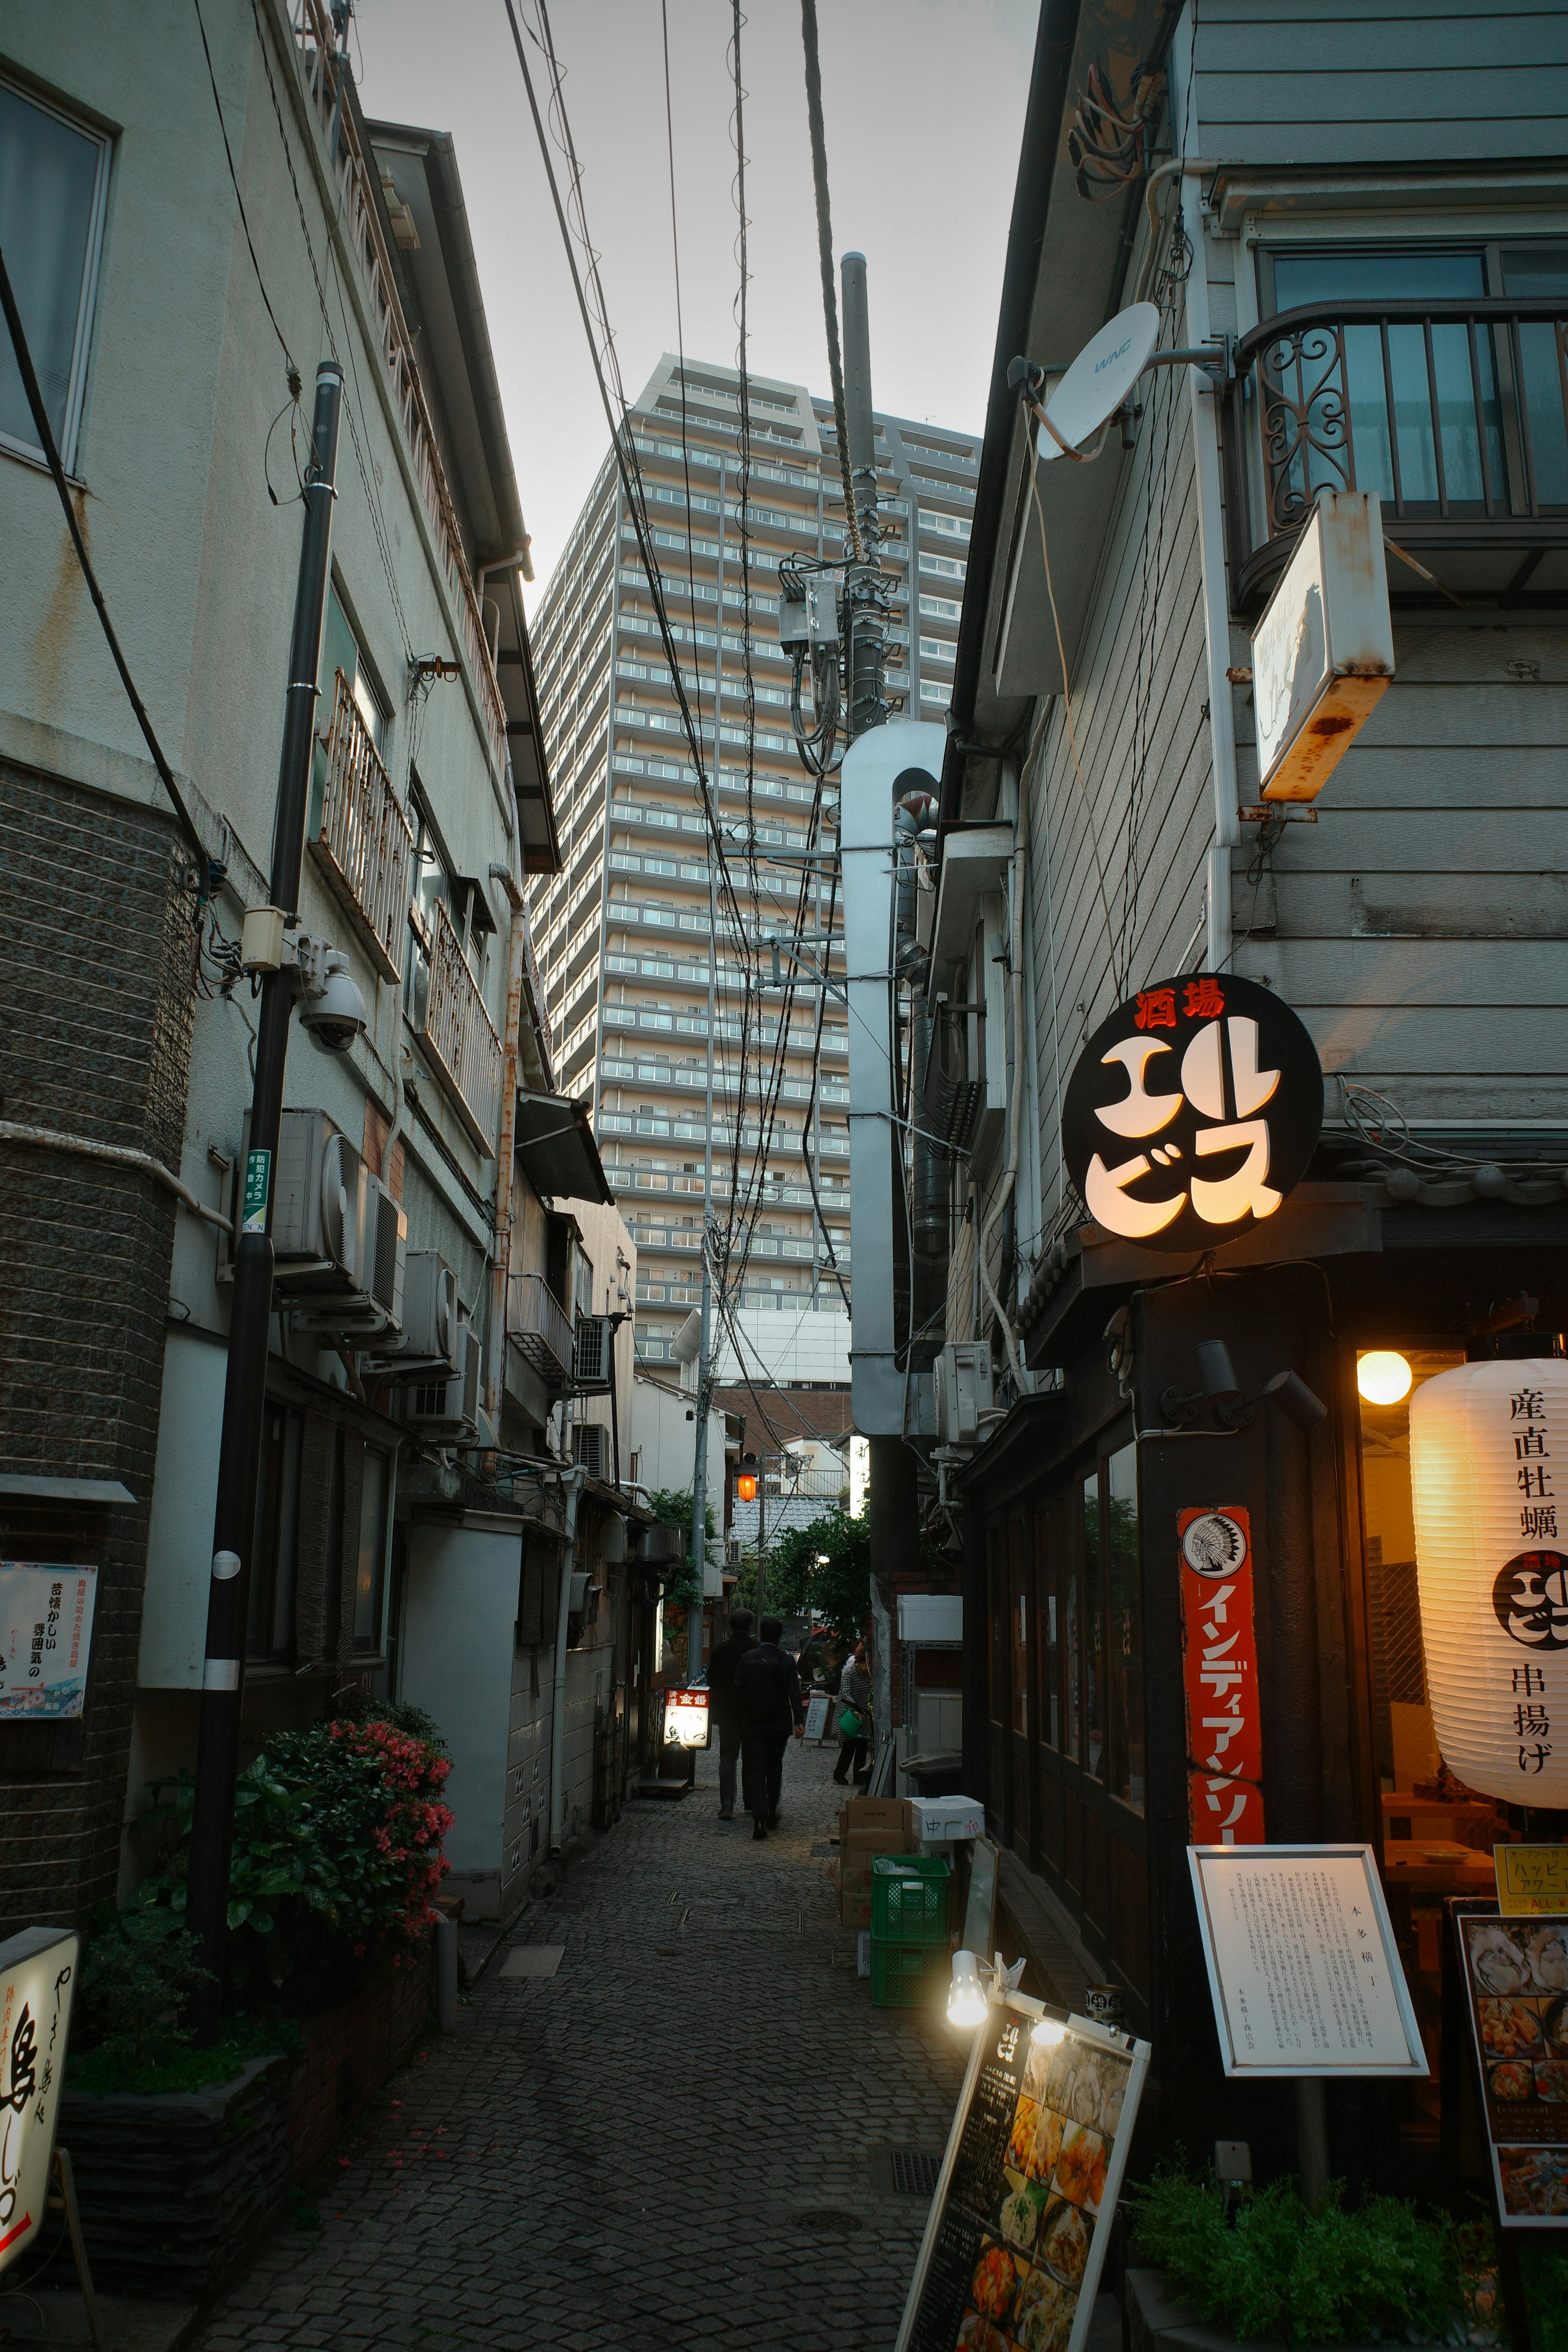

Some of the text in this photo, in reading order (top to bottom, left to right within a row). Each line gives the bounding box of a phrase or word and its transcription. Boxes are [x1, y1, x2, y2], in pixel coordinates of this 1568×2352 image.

[1095, 338, 1132, 374] WNC
[1134, 979, 1225, 1029] 酒場
[1094, 1016, 1281, 1138] エル
[246, 1156, 256, 1200] 作動中
[253, 1155, 265, 1200] 防犯カメラ
[1085, 1120, 1283, 1238] ビス
[242, 1223, 263, 1231] SENON
[1509, 1388, 1558, 1540] 産直牡蠣
[1523, 1553, 1561, 1570] 酒場
[45, 1582, 63, 1650] 昔懐かしい
[69, 1579, 86, 1668] 肉屋の始めた焼き鳥屋
[29, 1623, 45, 1678] 雰囲気の
[668, 1690, 707, 1706] 清酒 金婚
[1512, 1663, 1553, 1775] 串揚げ
[1531, 1898, 1553, 1908] ALL
[1351, 1906, 1378, 1986] 本多横丁
[1236, 1987, 1255, 2049] 本多横丁商店会
